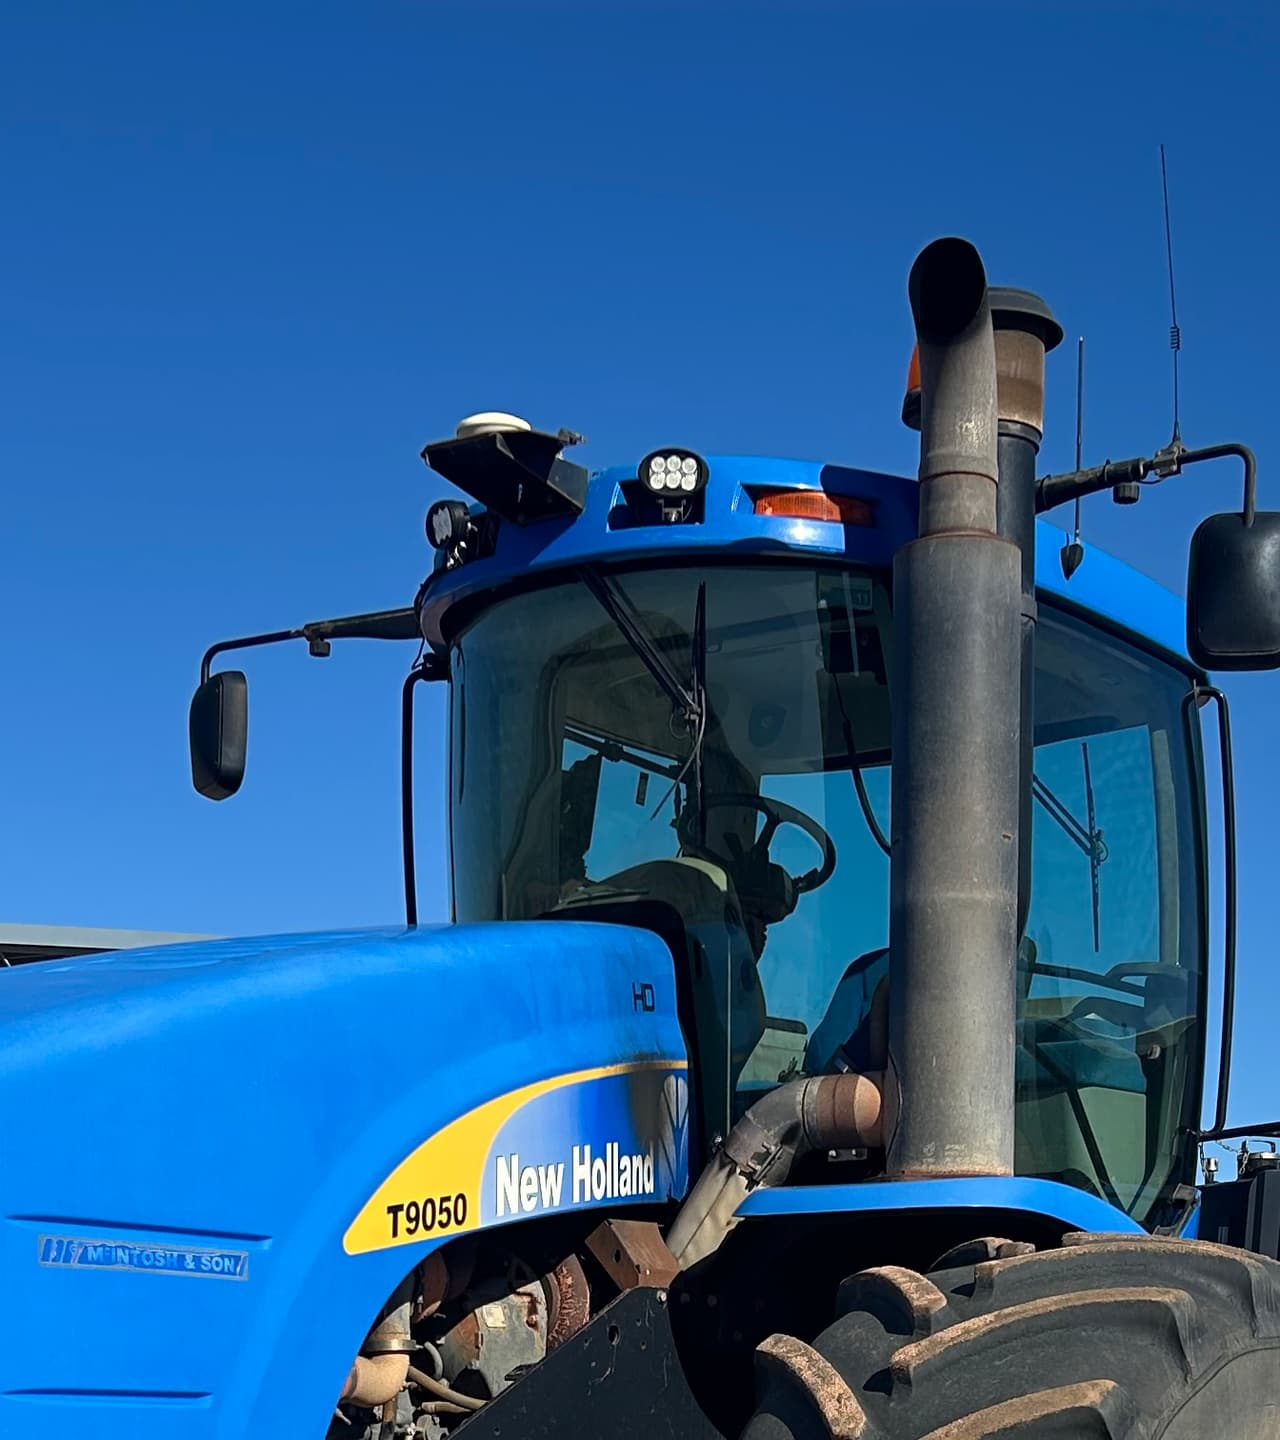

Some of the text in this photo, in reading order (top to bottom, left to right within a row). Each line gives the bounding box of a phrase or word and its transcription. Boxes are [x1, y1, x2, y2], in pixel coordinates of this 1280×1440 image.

[631, 982, 656, 1013] HD
[495, 1142, 654, 1217] New Holland
[386, 1193, 468, 1239] T9050
[183, 1254, 196, 1270] &
[200, 1255, 235, 1273] SON
